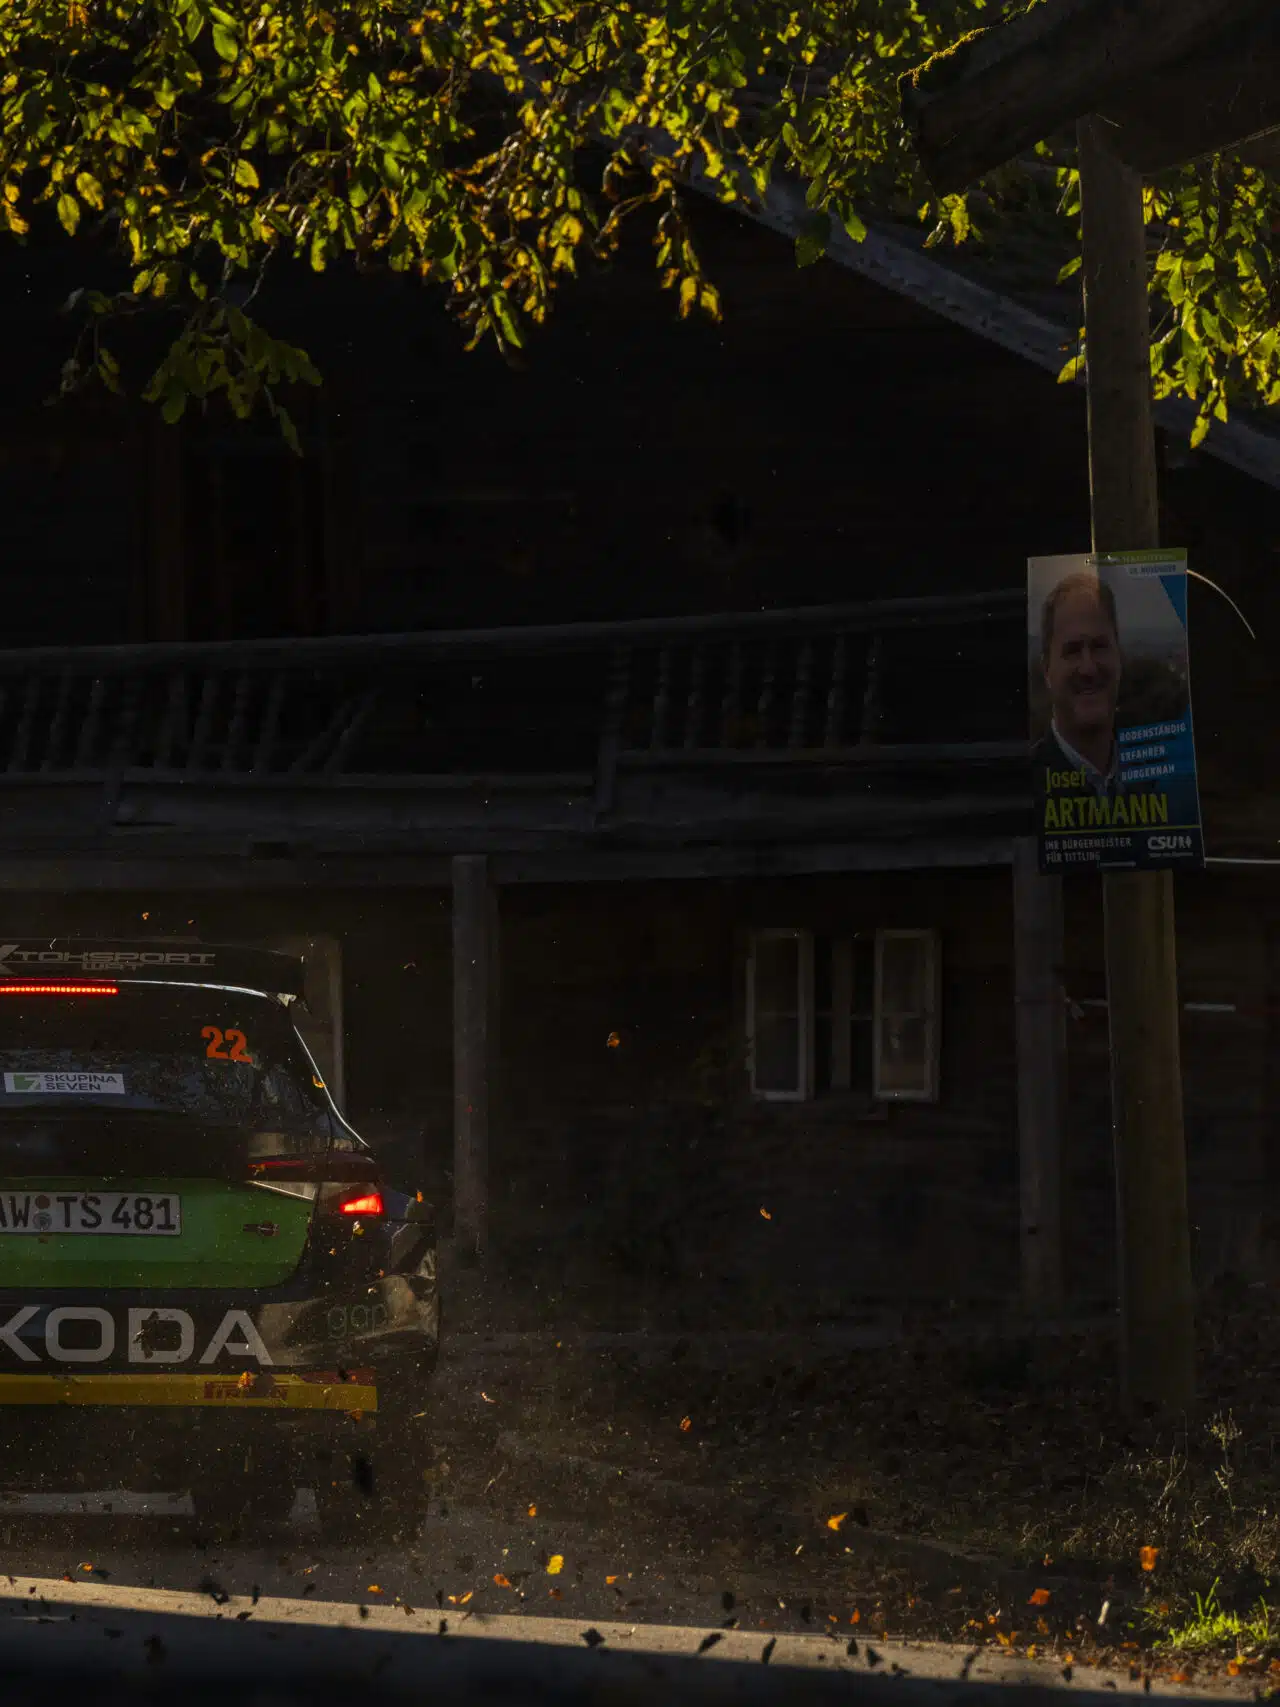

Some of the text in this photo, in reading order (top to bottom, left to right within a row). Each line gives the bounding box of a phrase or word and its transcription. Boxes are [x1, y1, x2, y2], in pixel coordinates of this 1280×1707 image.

[1044, 764, 1087, 793] Josef
[1043, 793, 1169, 828] ARTMANN
[200, 1025, 253, 1063] 22
[44, 1074, 118, 1084] SKUPINA
[46, 1083, 102, 1091] SEVEN
[56, 1196, 102, 1229] TS
[111, 1197, 176, 1231] 481
